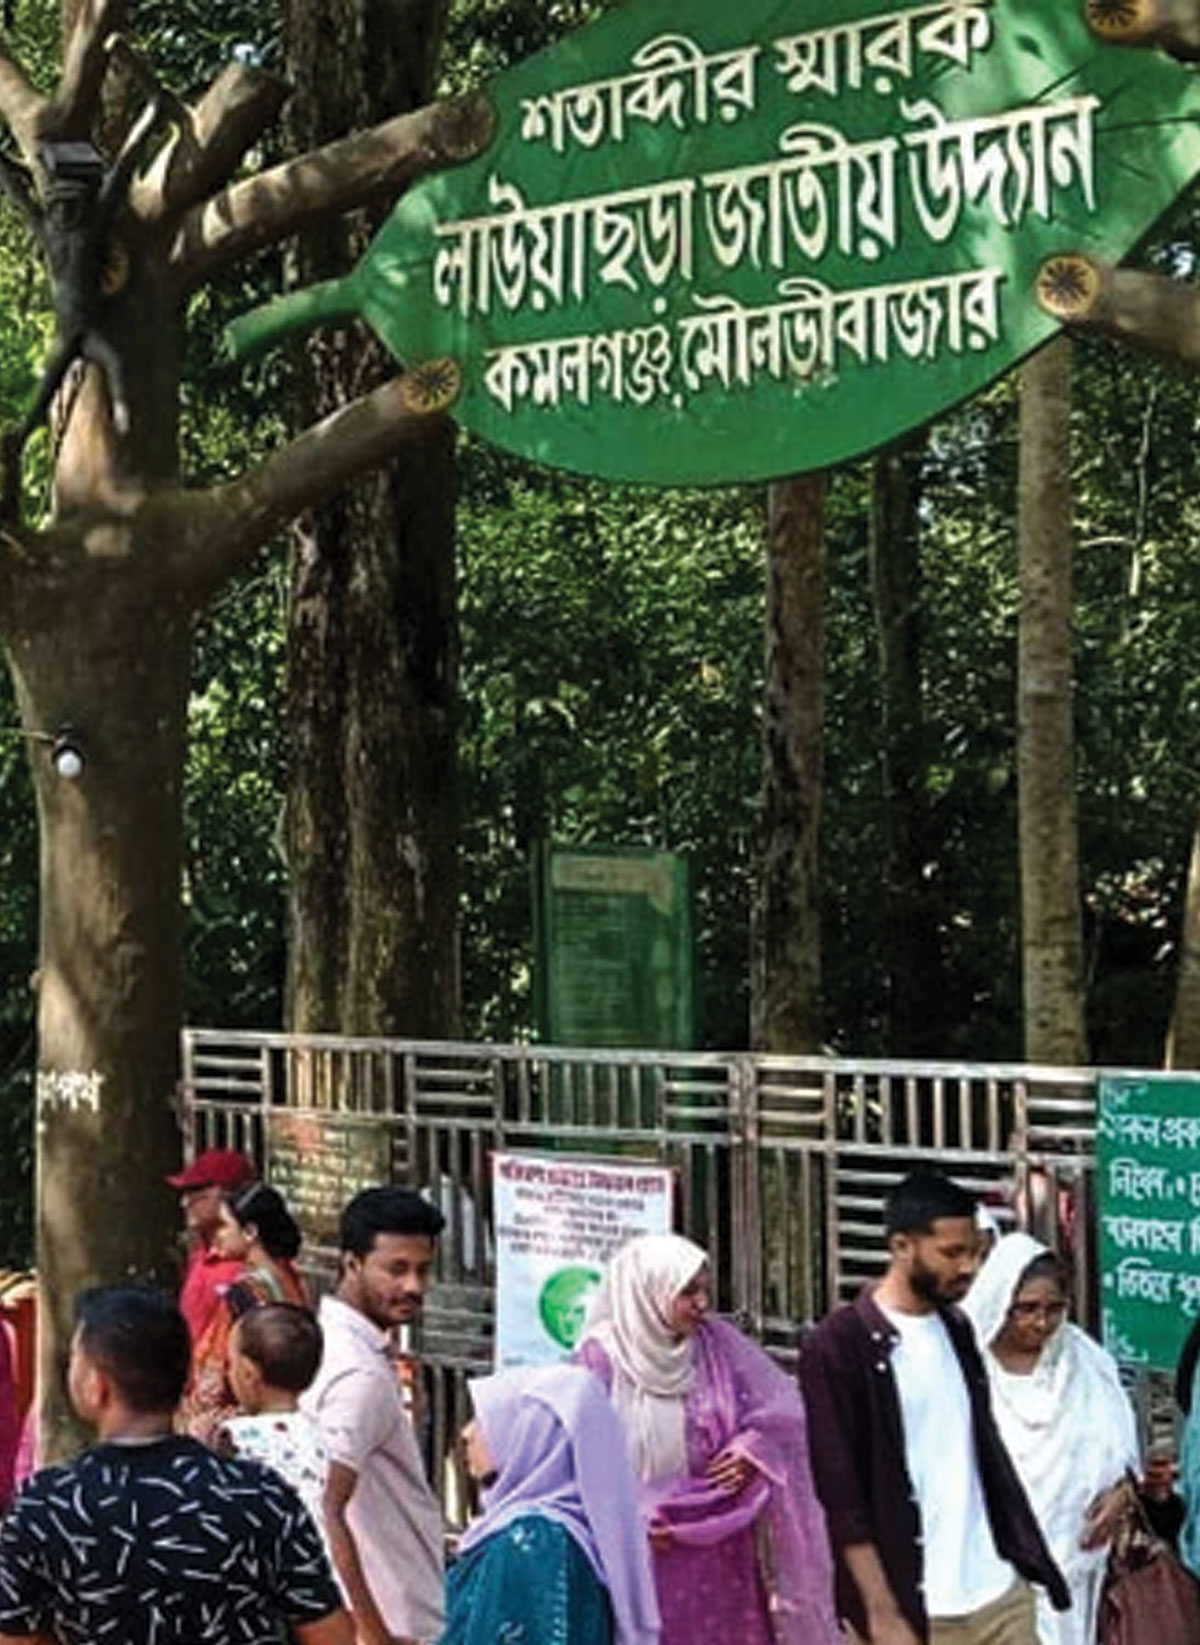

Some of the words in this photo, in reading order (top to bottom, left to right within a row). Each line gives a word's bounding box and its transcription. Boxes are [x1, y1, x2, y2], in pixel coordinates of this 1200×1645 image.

[520, 38, 756, 153] শতাব্দীর
[774, 0, 996, 96] স্মারক
[434, 176, 696, 316] লাউয়াছড়া
[704, 124, 900, 270] জাতীয়
[902, 95, 1102, 242] উদ্যান
